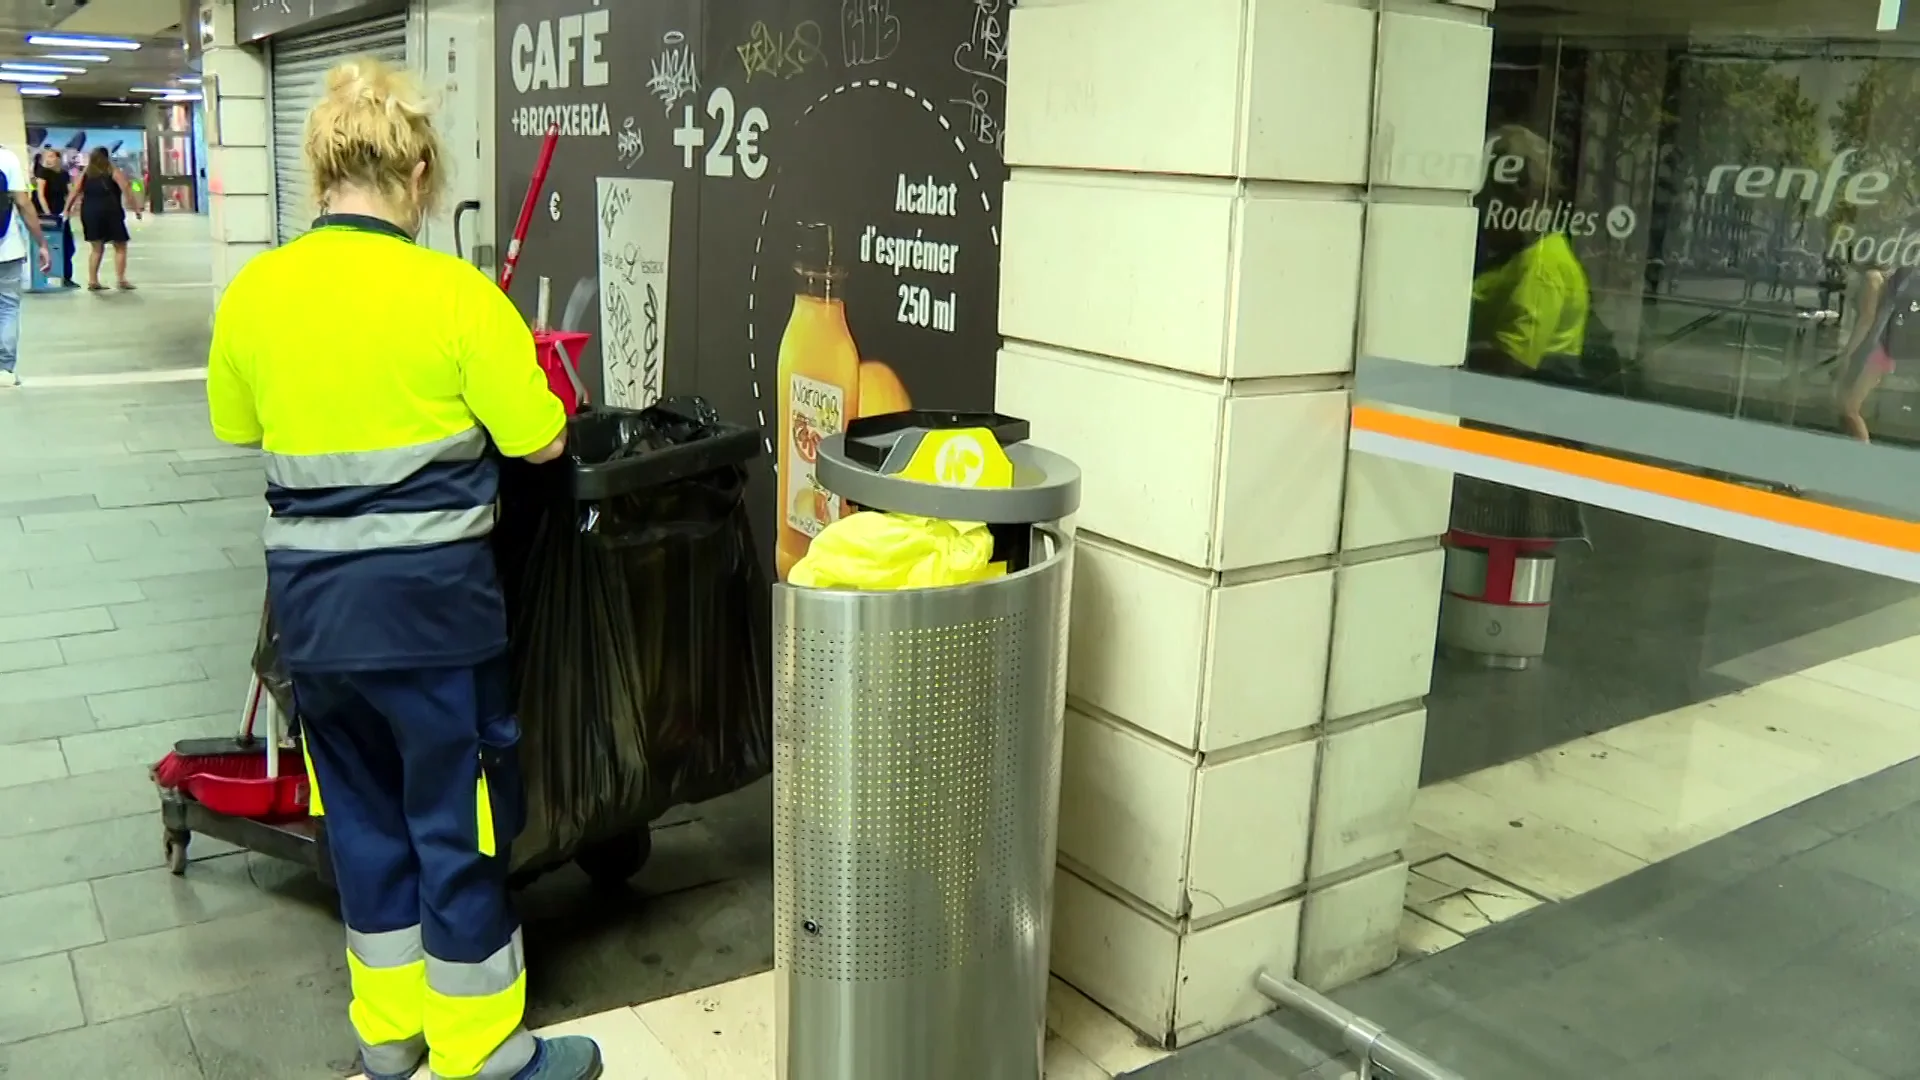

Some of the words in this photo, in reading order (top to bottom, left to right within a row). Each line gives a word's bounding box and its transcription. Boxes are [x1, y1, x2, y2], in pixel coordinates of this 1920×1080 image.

[511, 0, 609, 93] CAFÉ
[895, 173, 958, 217] Acabat
[1705, 149, 1890, 218] renfe
[1484, 199, 1600, 236] Rodalies
[860, 225, 960, 276] d'esprémer
[897, 283, 931, 328] 250
[932, 291, 957, 332] ml
